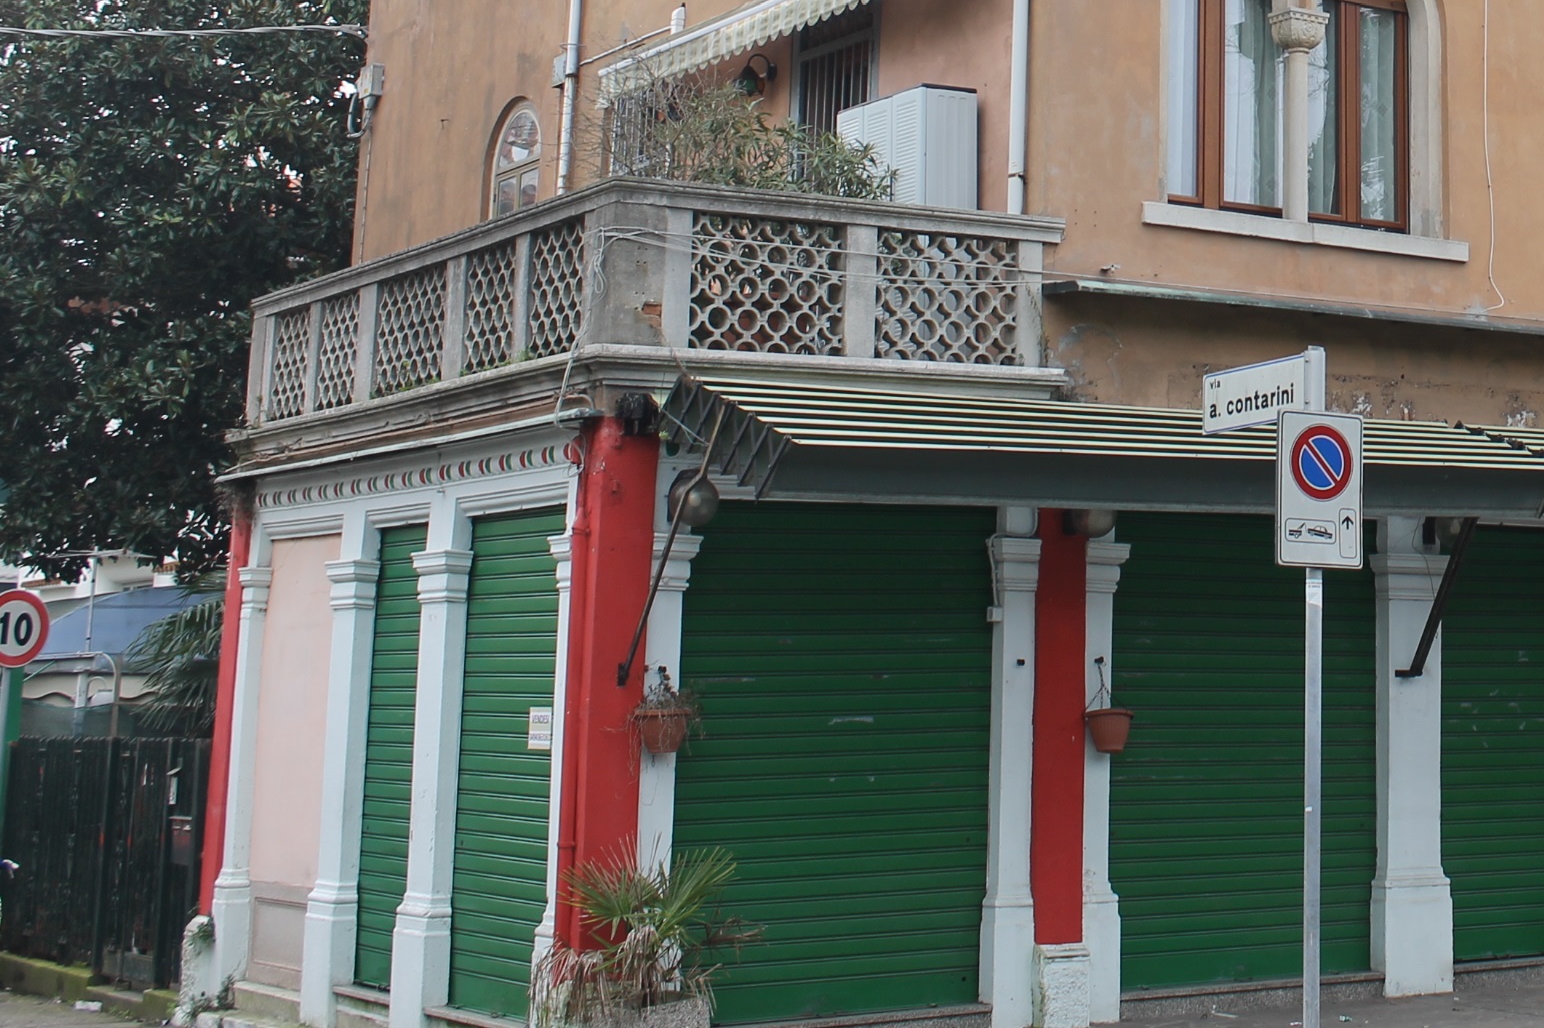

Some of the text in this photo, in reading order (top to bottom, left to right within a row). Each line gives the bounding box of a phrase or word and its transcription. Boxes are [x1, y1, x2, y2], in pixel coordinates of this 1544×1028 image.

[1209, 382, 1295, 419] a. contarini
[1210, 379, 1222, 389] via
[0, 611, 33, 647] 10
